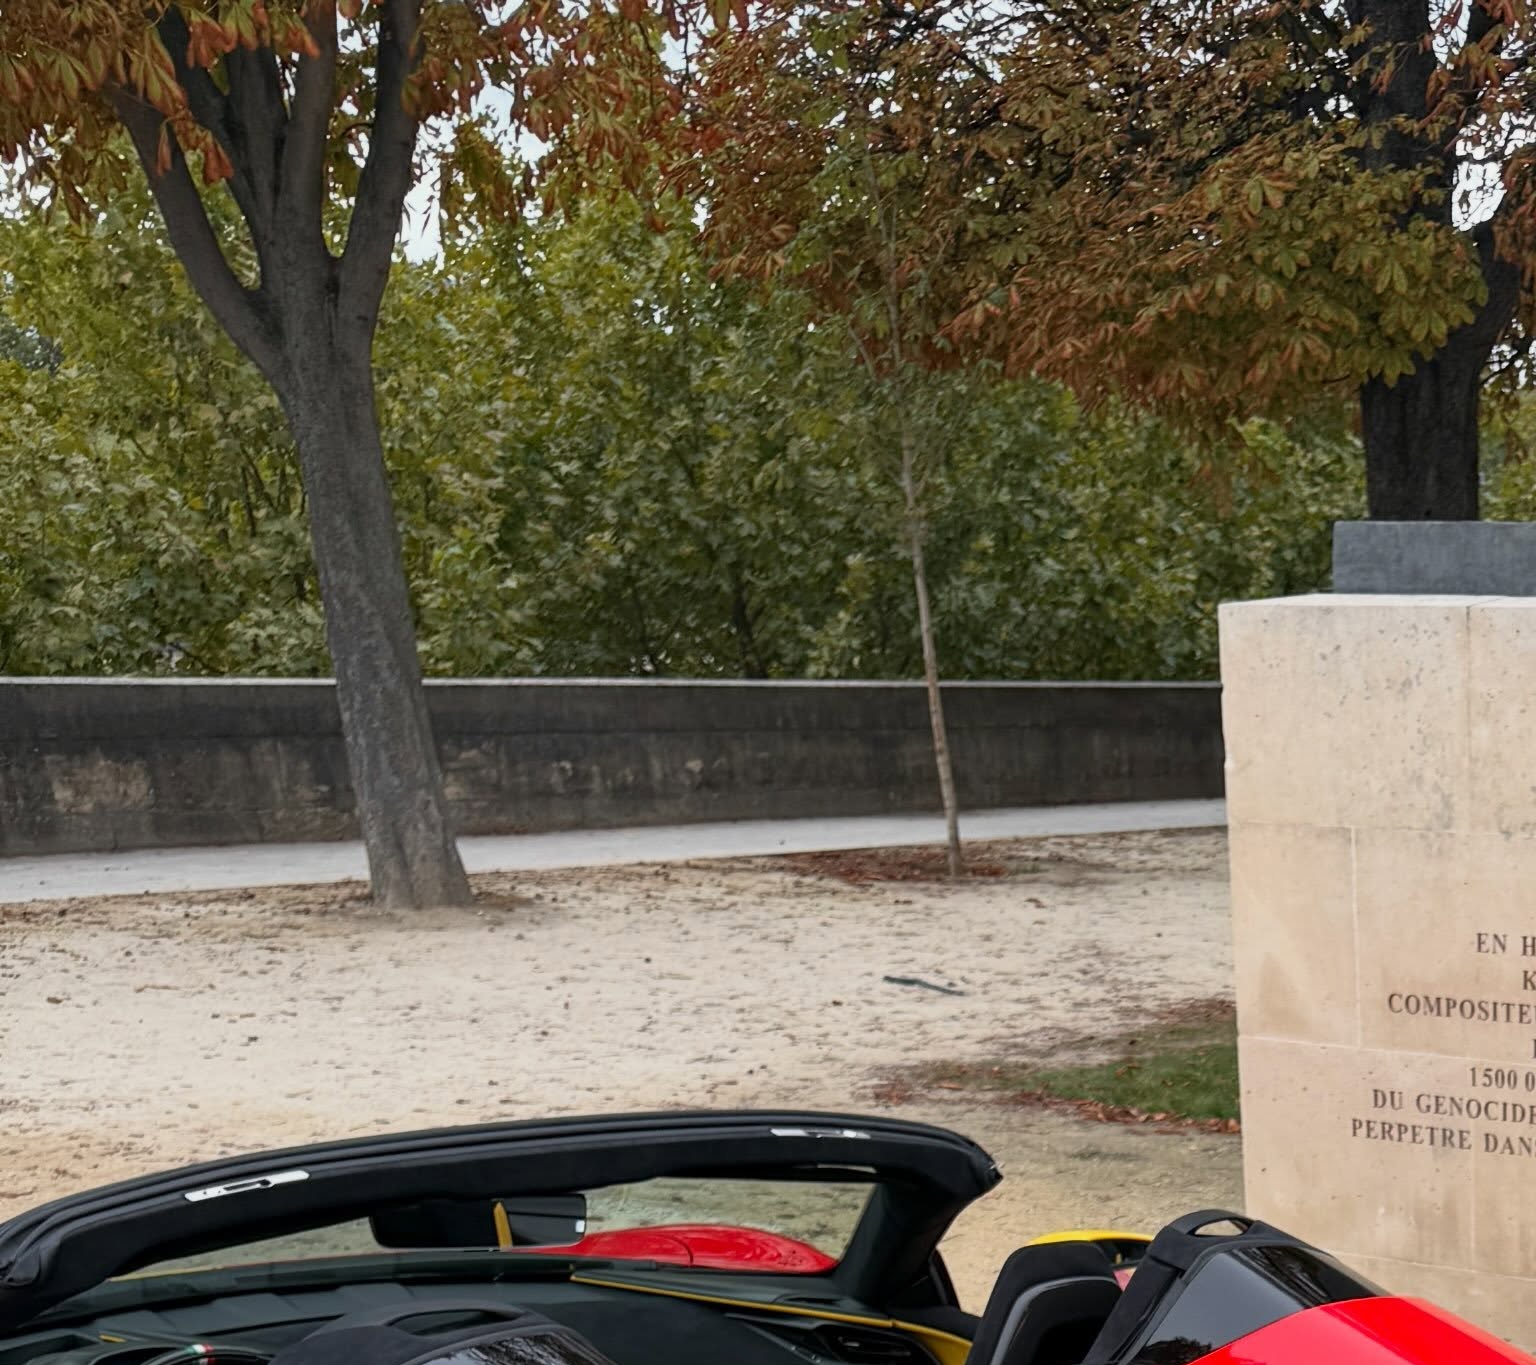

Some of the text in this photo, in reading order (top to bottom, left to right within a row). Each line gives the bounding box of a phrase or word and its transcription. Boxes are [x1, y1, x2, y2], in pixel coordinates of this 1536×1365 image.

[1476, 932, 1508, 955] EN
[1470, 1067, 1518, 1090] 1500
[1372, 1089, 1404, 1110] DU
[1351, 1118, 1473, 1151] PERPETRE
